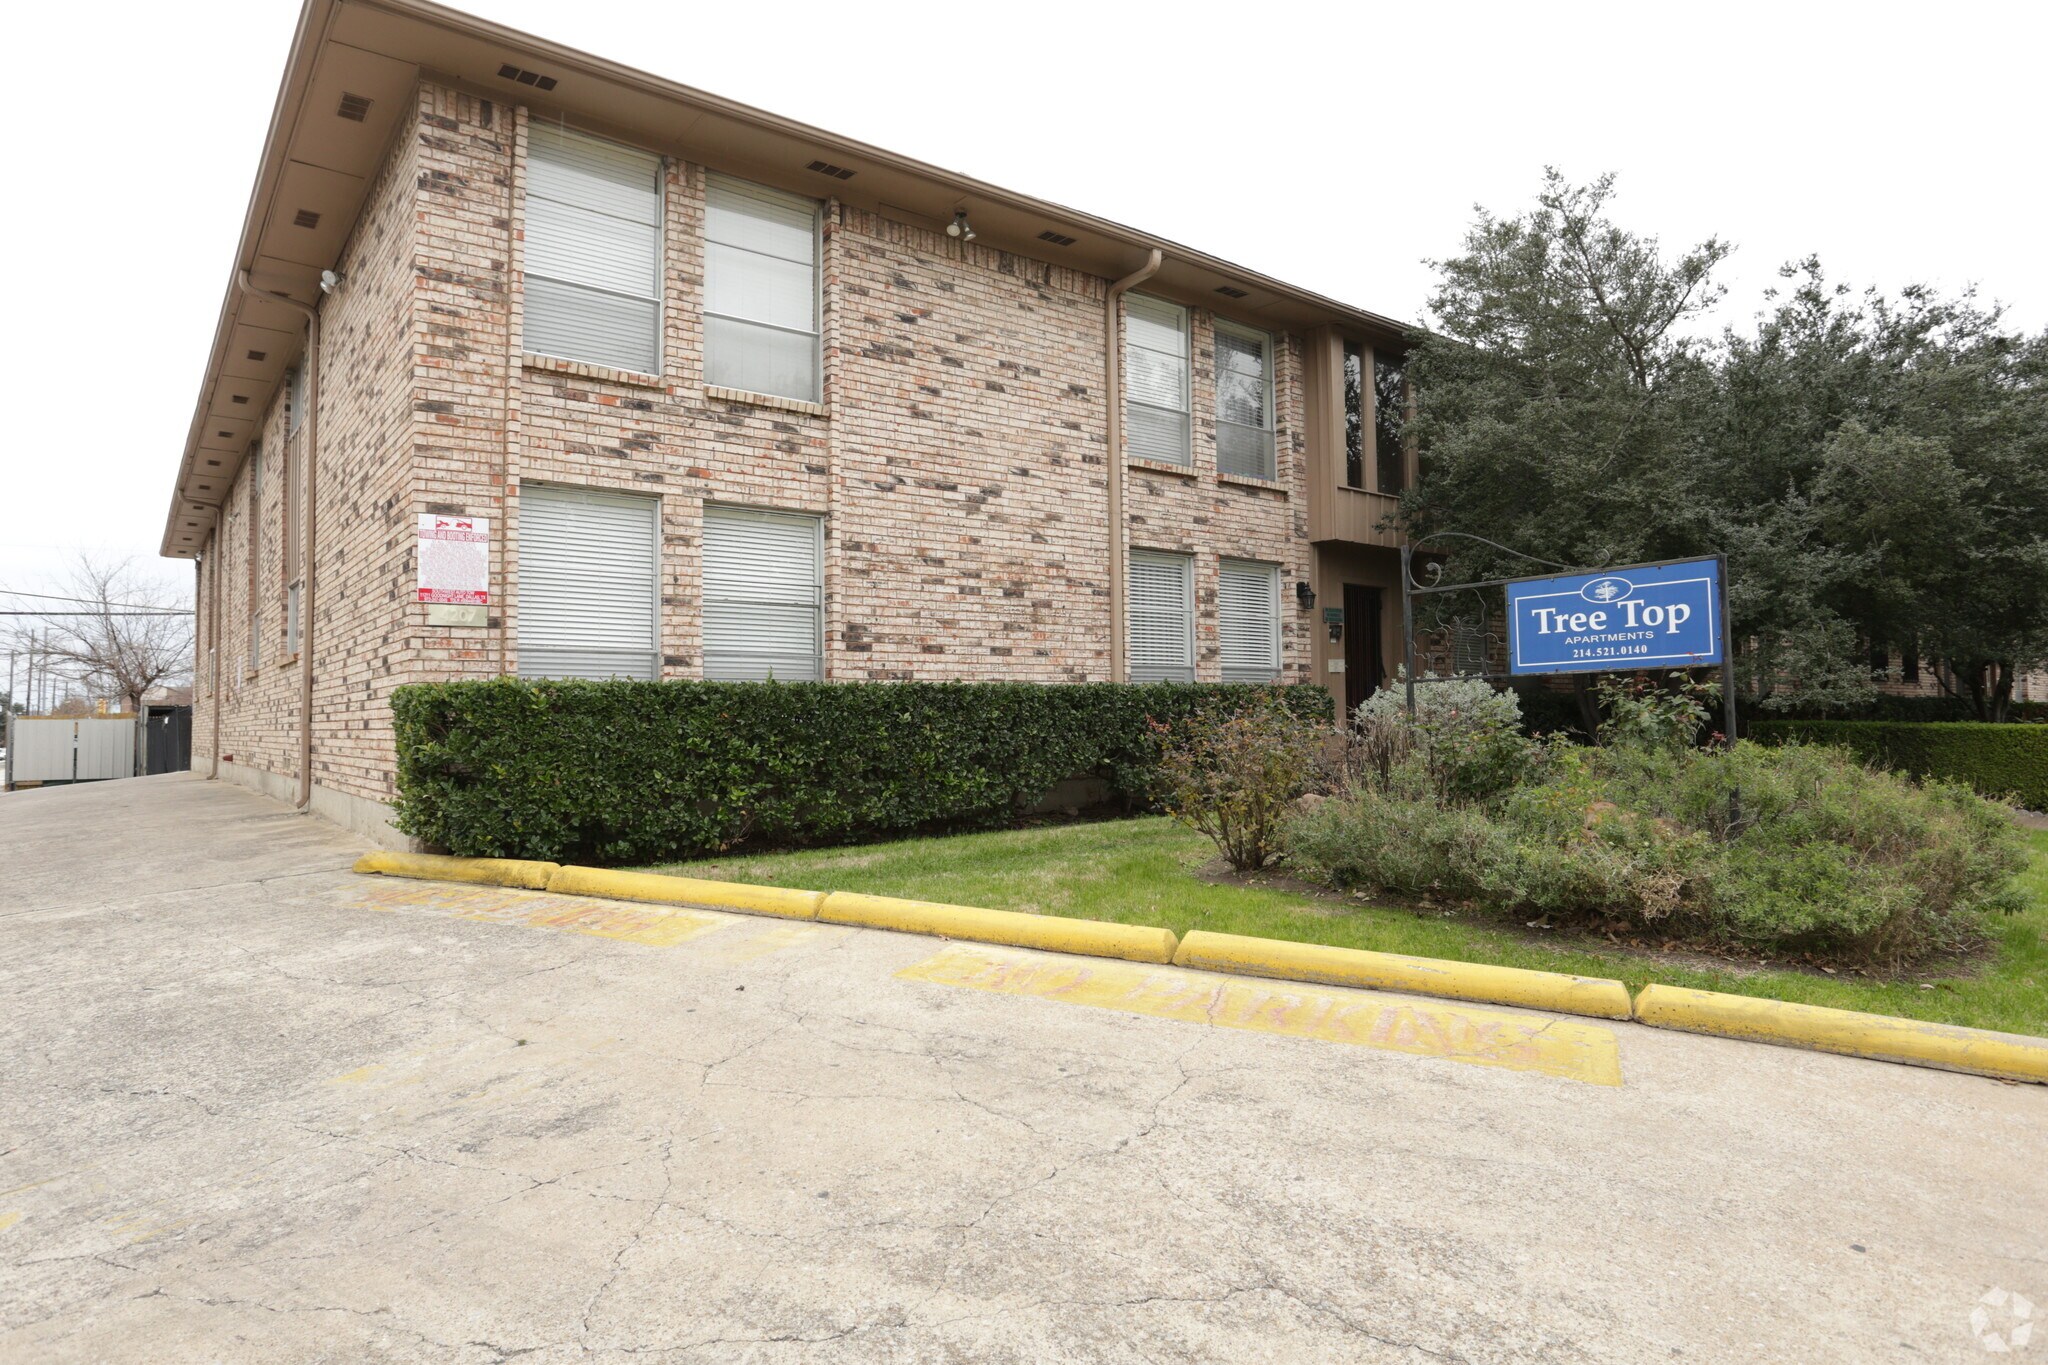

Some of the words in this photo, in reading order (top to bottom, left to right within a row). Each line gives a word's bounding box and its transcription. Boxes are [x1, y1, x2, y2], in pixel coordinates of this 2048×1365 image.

[419, 530, 438, 539] TOWING
[437, 530, 447, 540] AND
[447, 531, 466, 541] BOOTING
[467, 533, 488, 543] ENFORCED
[440, 607, 477, 622] 4207
[1531, 607, 1607, 635] Tree
[1617, 599, 1691, 634] Top
[1565, 631, 1654, 645] APARTMENTS
[1573, 644, 1648, 658] 214.521.0140
[1117, 973, 1545, 1063] PARKING
